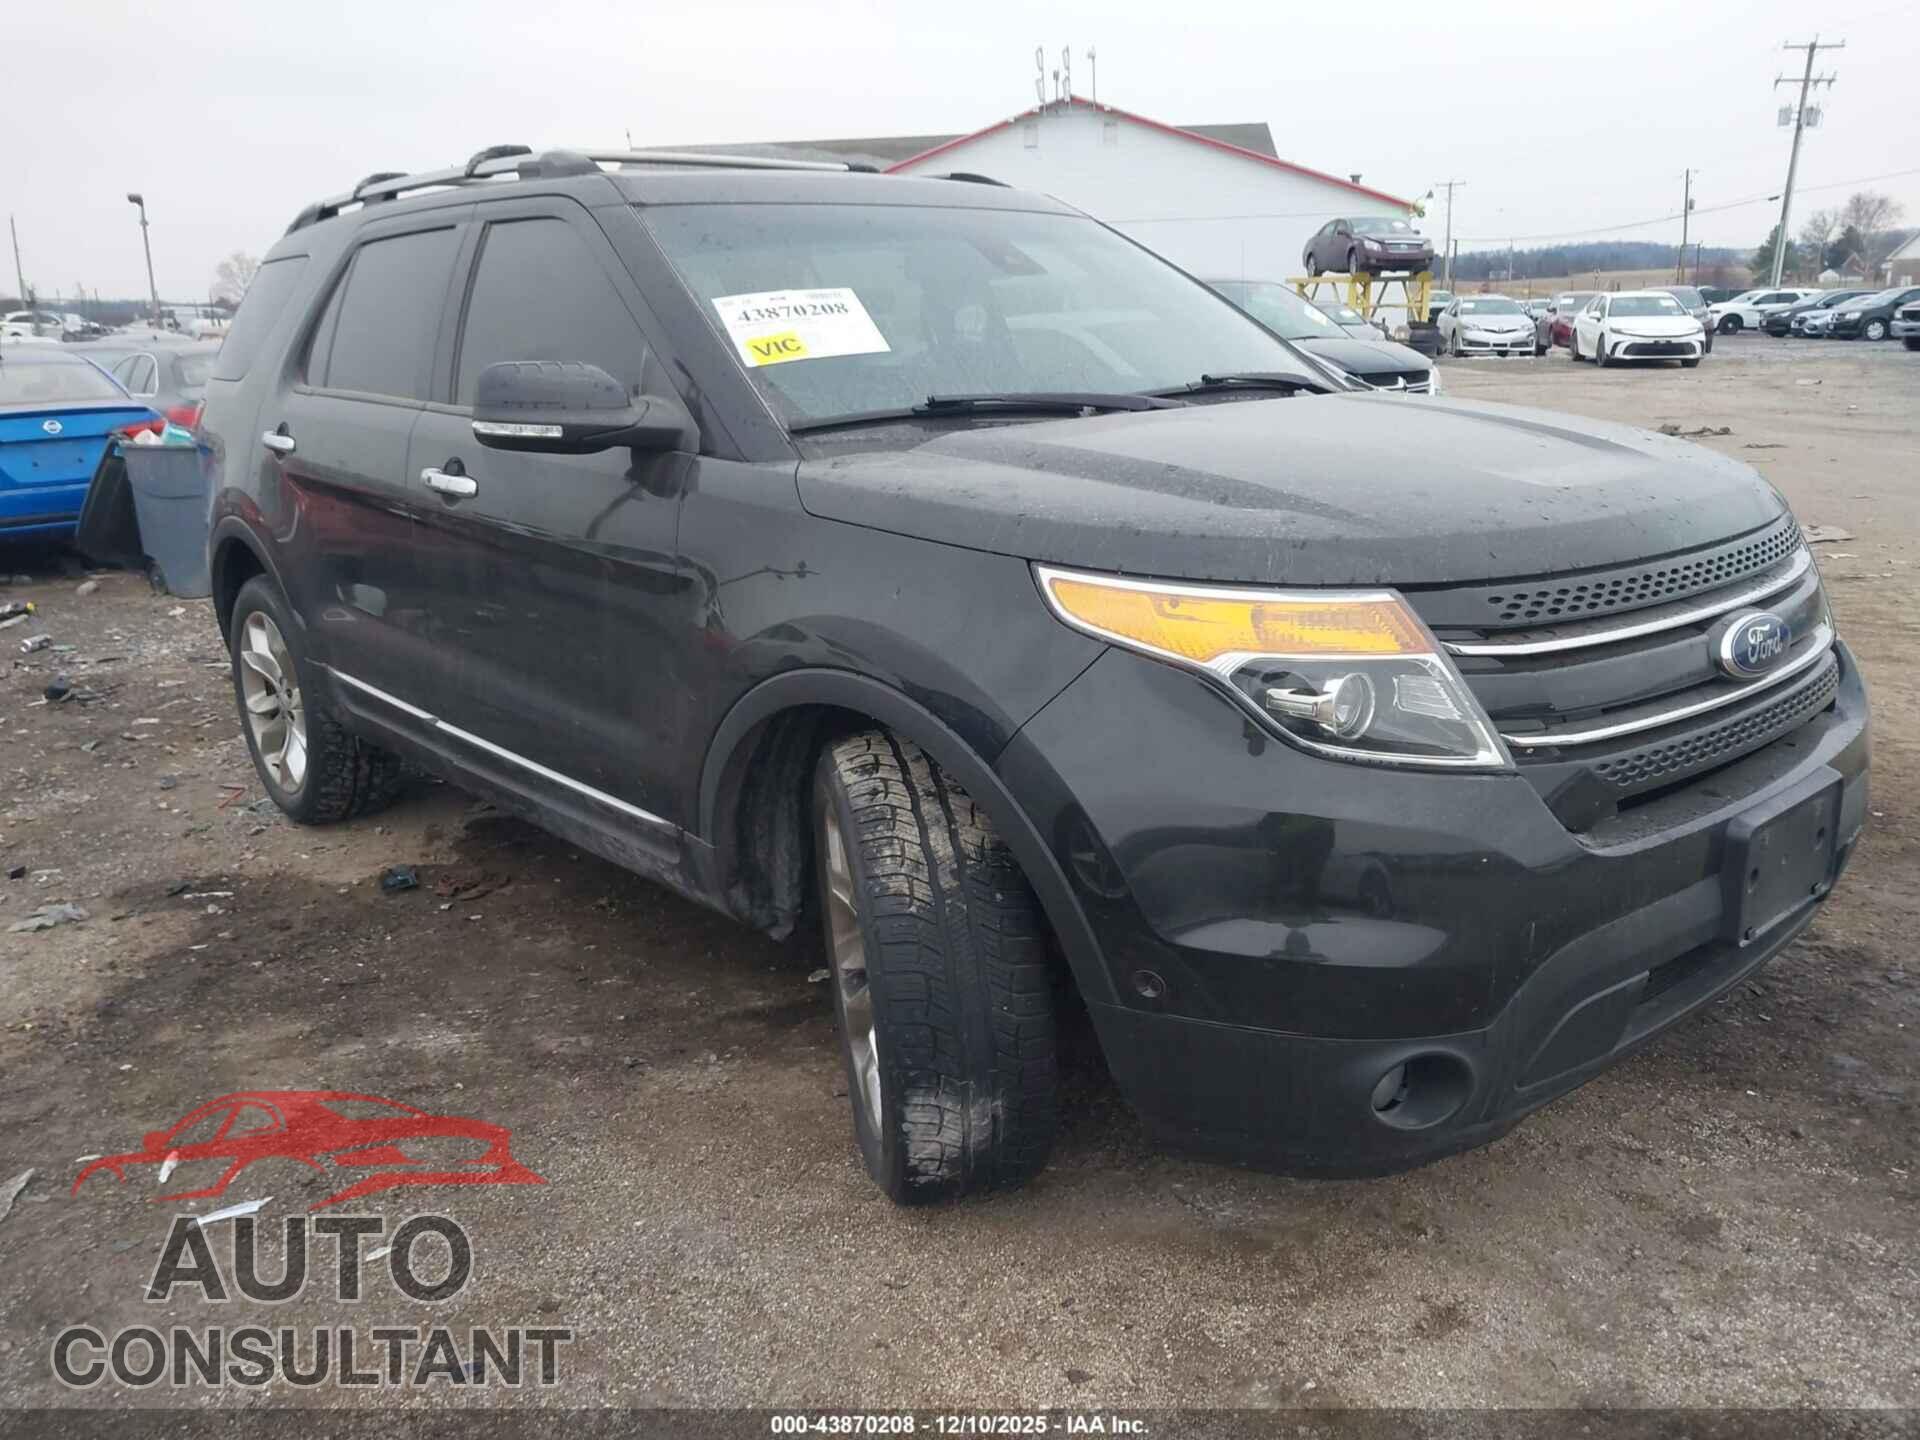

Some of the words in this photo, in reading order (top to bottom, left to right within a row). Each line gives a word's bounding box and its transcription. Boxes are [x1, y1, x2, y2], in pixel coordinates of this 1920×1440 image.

[738, 302, 849, 322] 43870208
[753, 338, 801, 357] VIC
[1748, 623, 1784, 664] Ford
